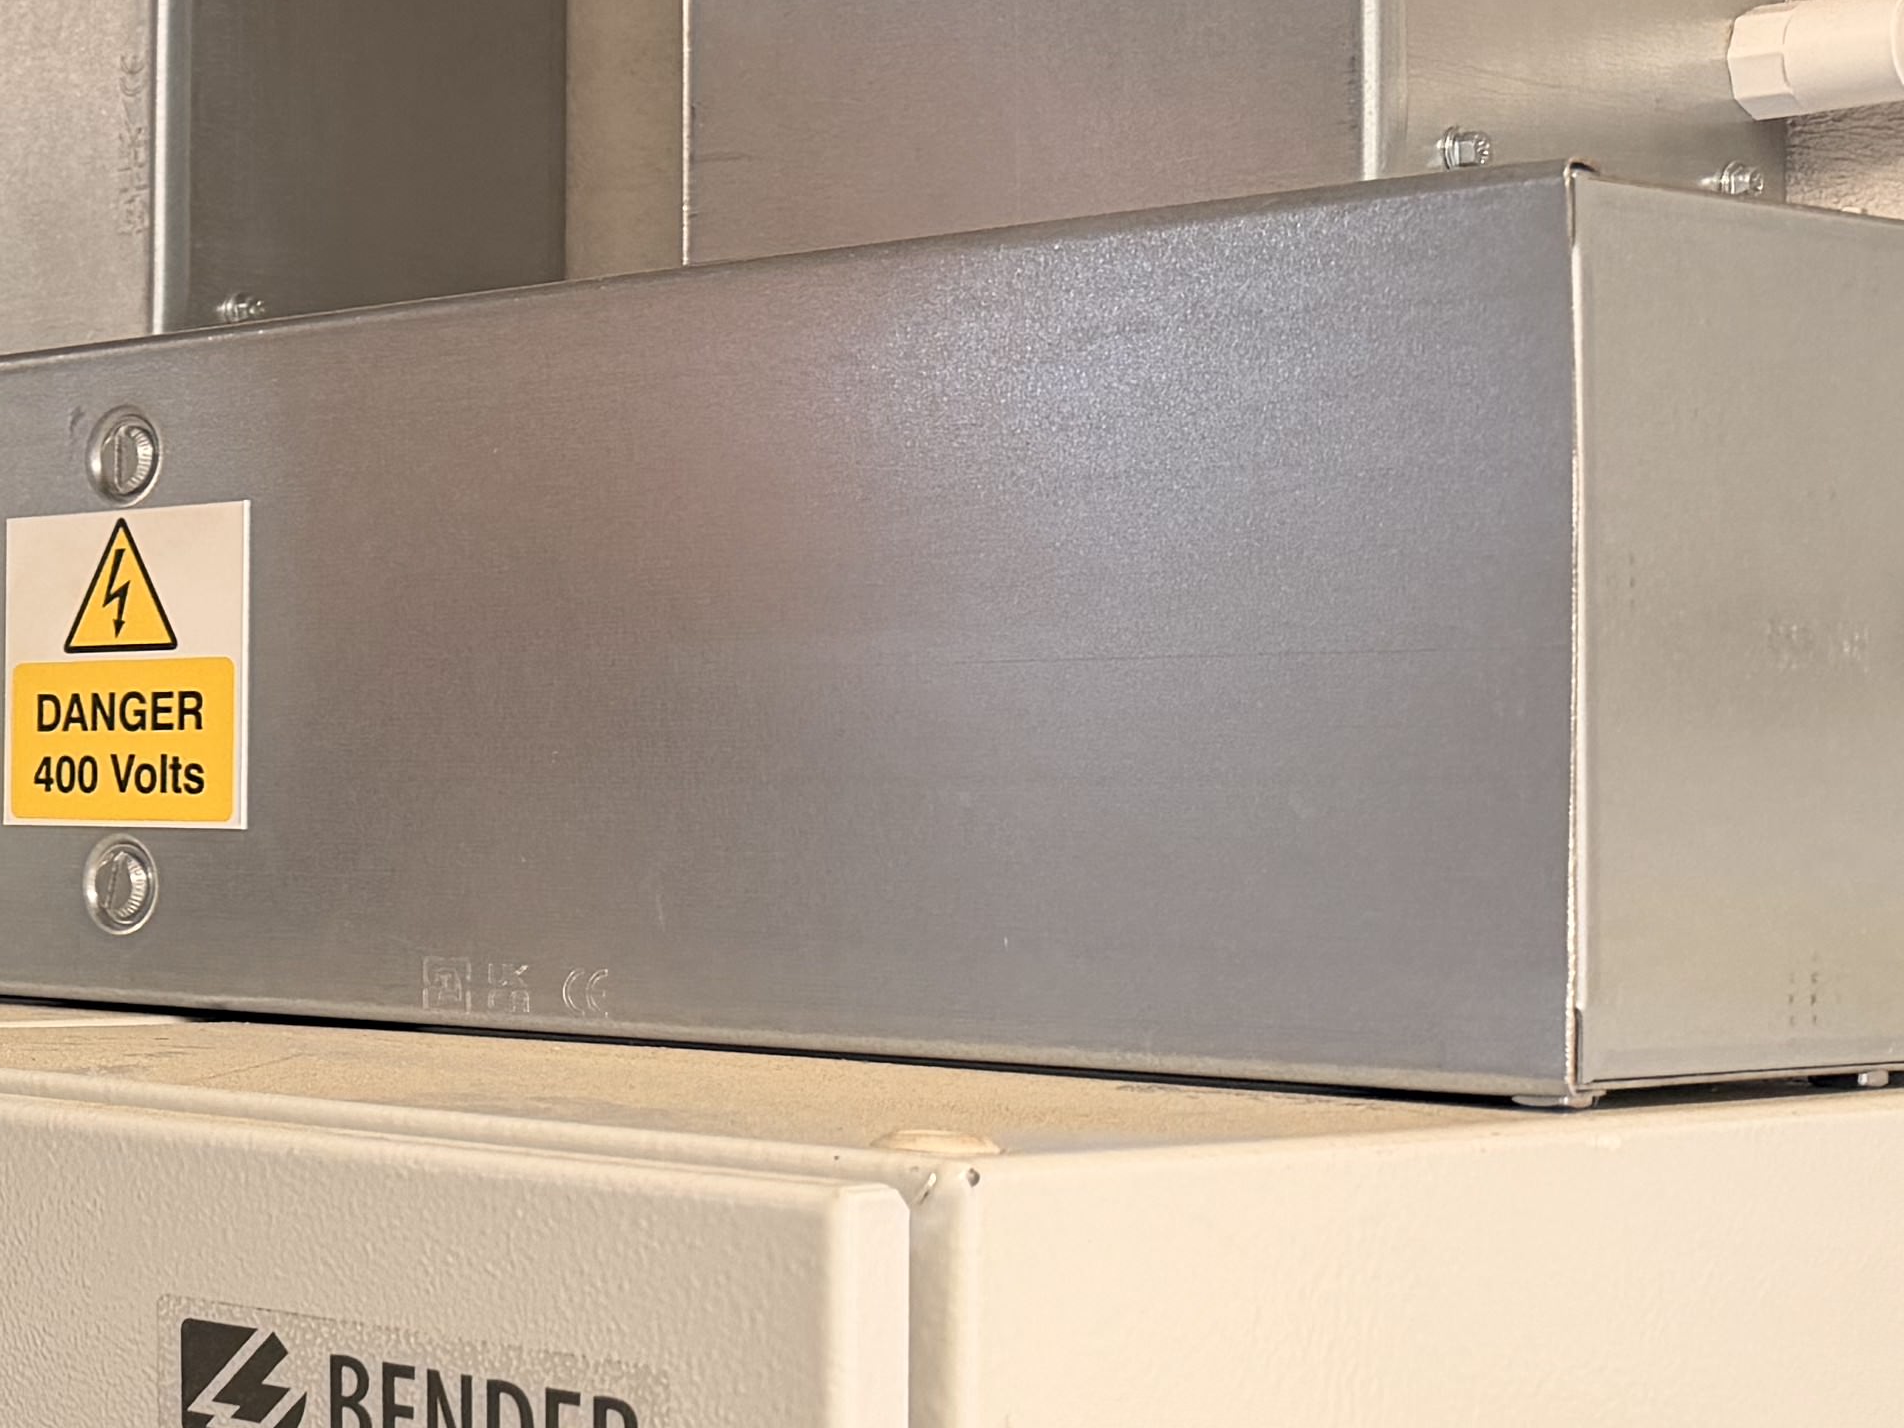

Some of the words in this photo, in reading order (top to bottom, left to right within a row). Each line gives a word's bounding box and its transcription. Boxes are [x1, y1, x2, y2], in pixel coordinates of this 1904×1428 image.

[36, 690, 203, 732] DANGER
[34, 755, 98, 794] 400
[111, 754, 205, 794] Volts
